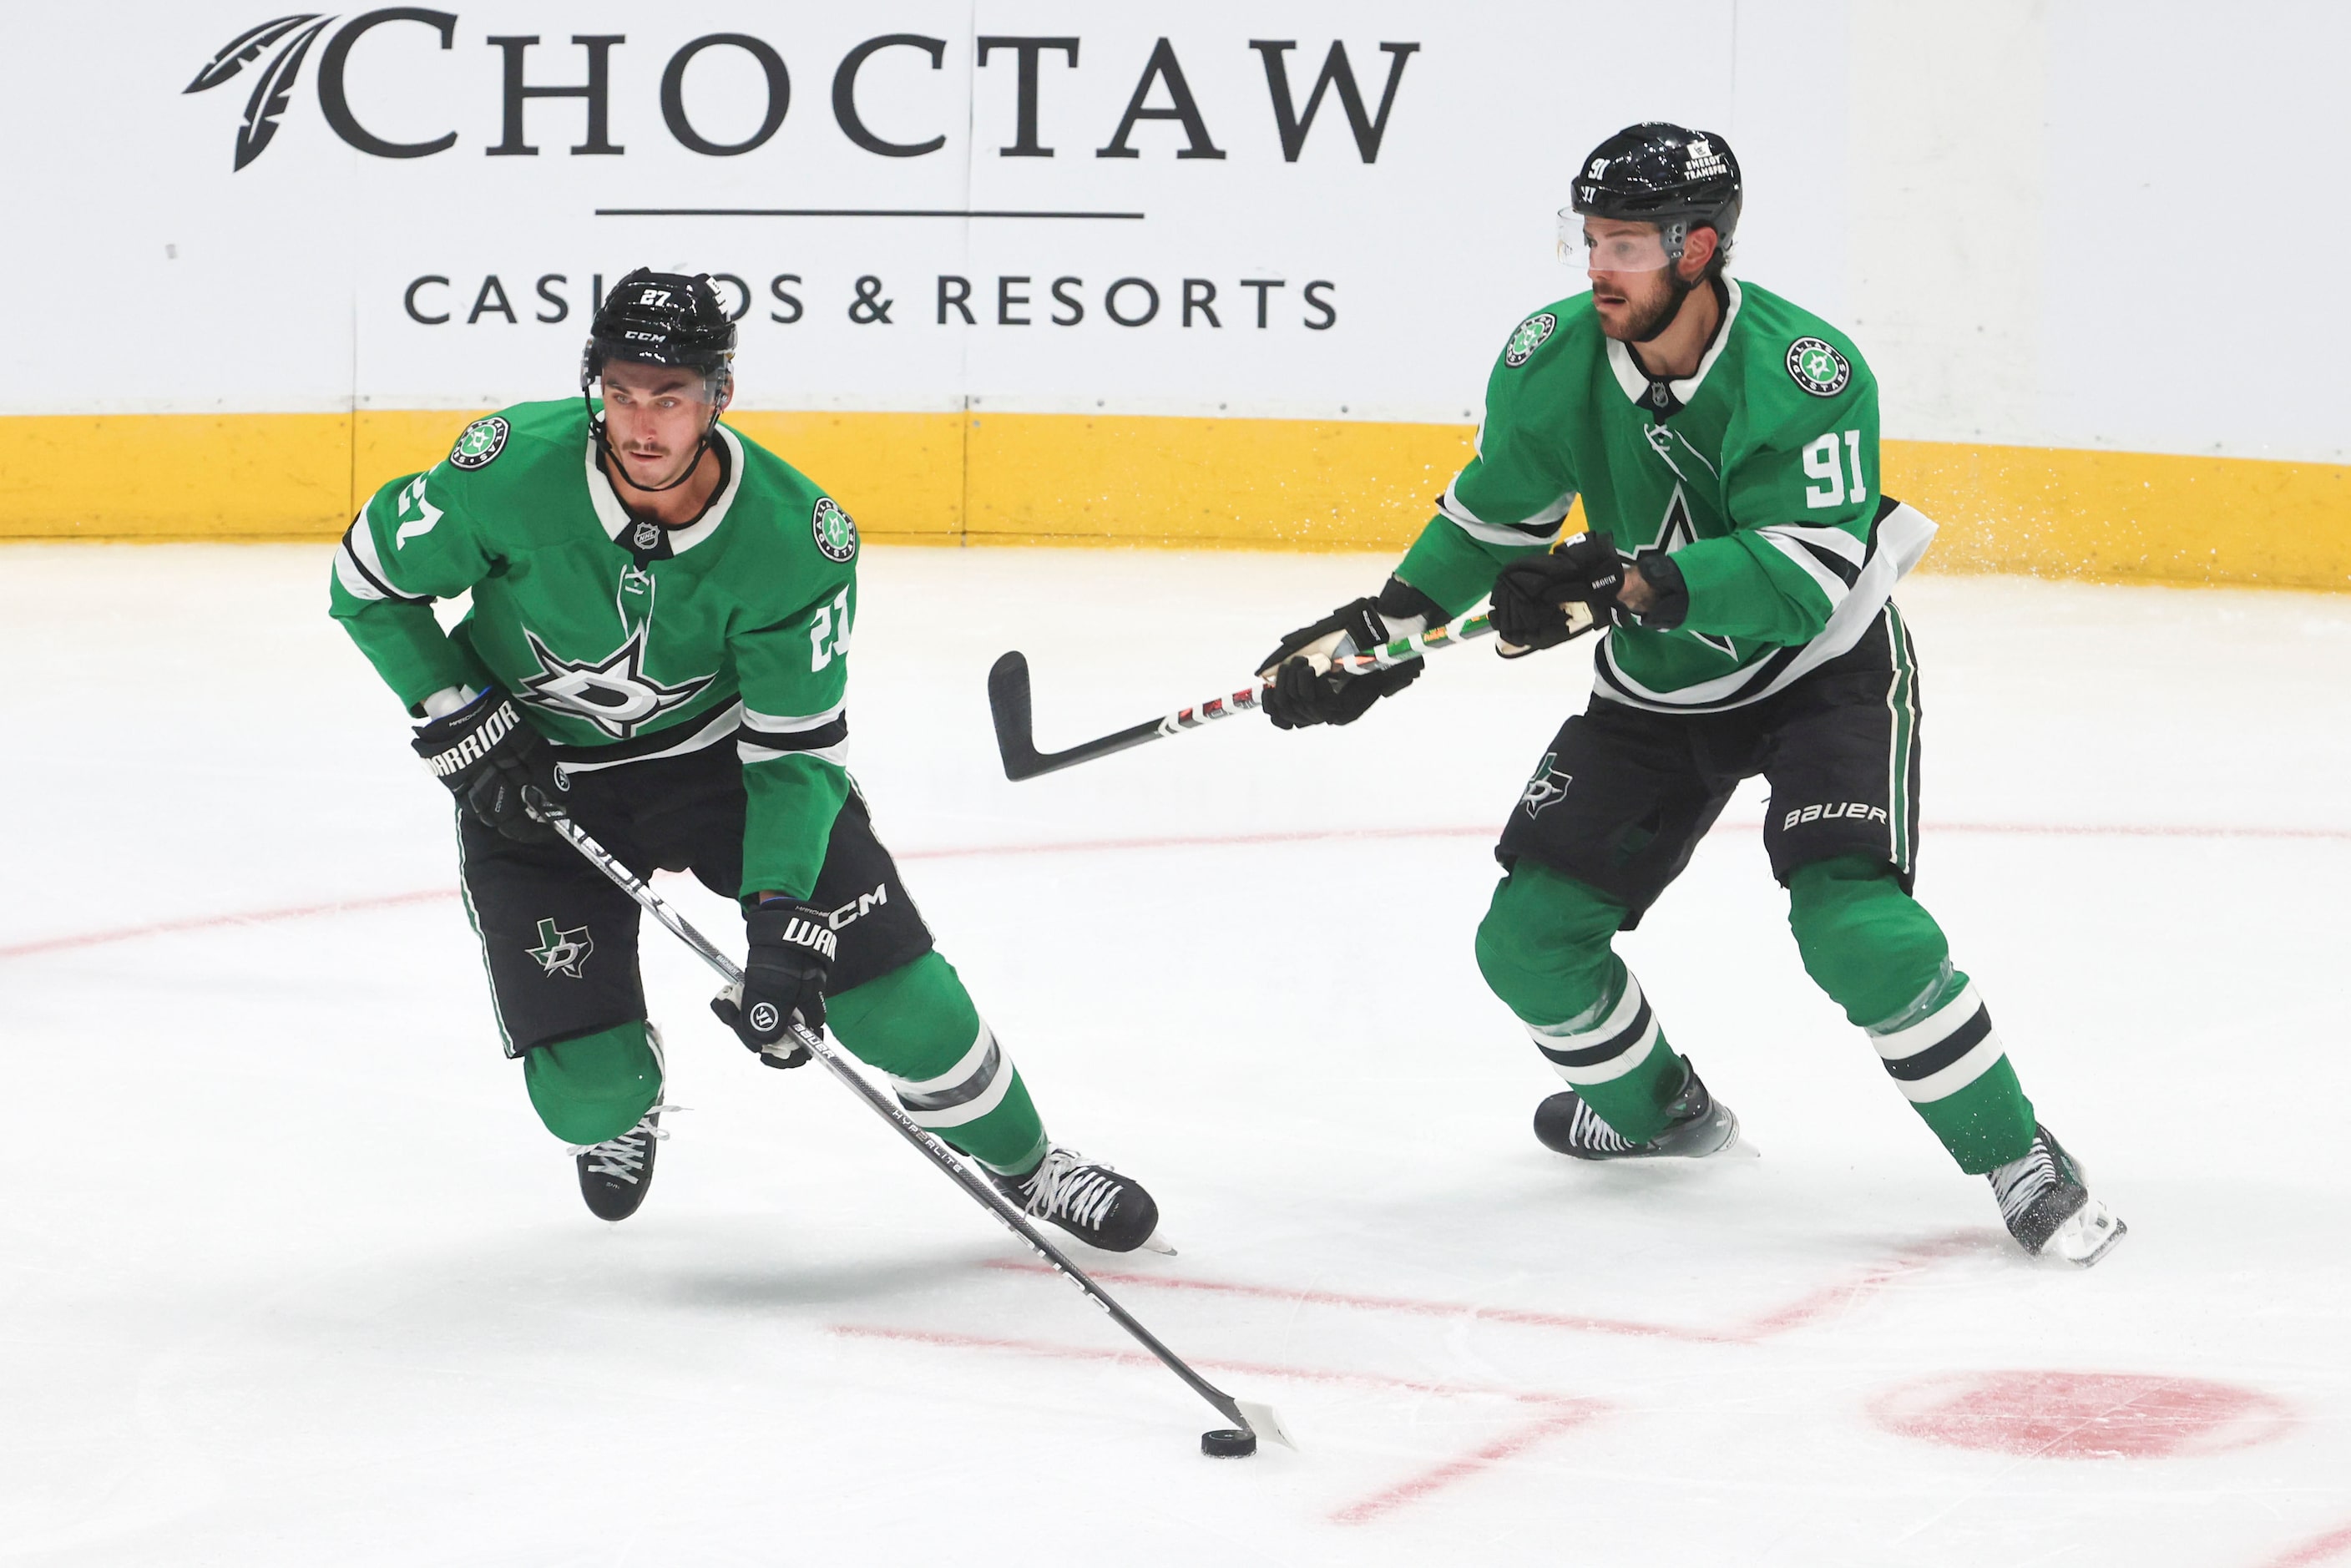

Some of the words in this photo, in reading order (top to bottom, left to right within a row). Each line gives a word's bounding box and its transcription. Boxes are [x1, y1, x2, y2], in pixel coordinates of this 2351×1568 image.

[317, 7, 1420, 164] CHOCTAW
[1588, 158, 1610, 180] 91
[1683, 164, 1727, 180] TRANSFER
[1685, 154, 1722, 171] ENERGY
[404, 274, 803, 325] CASIOS
[848, 276, 893, 325] &
[937, 276, 1337, 331] RESORTS
[640, 288, 671, 307] 27
[624, 331, 666, 343] CCM
[1791, 341, 1833, 374] DALLAS
[1808, 362, 1847, 392] STARS
[1802, 429, 1867, 509] 91
[1782, 802, 1888, 832] BAUER
[829, 883, 887, 930] CM
[792, 1023, 836, 1060] BAUER
